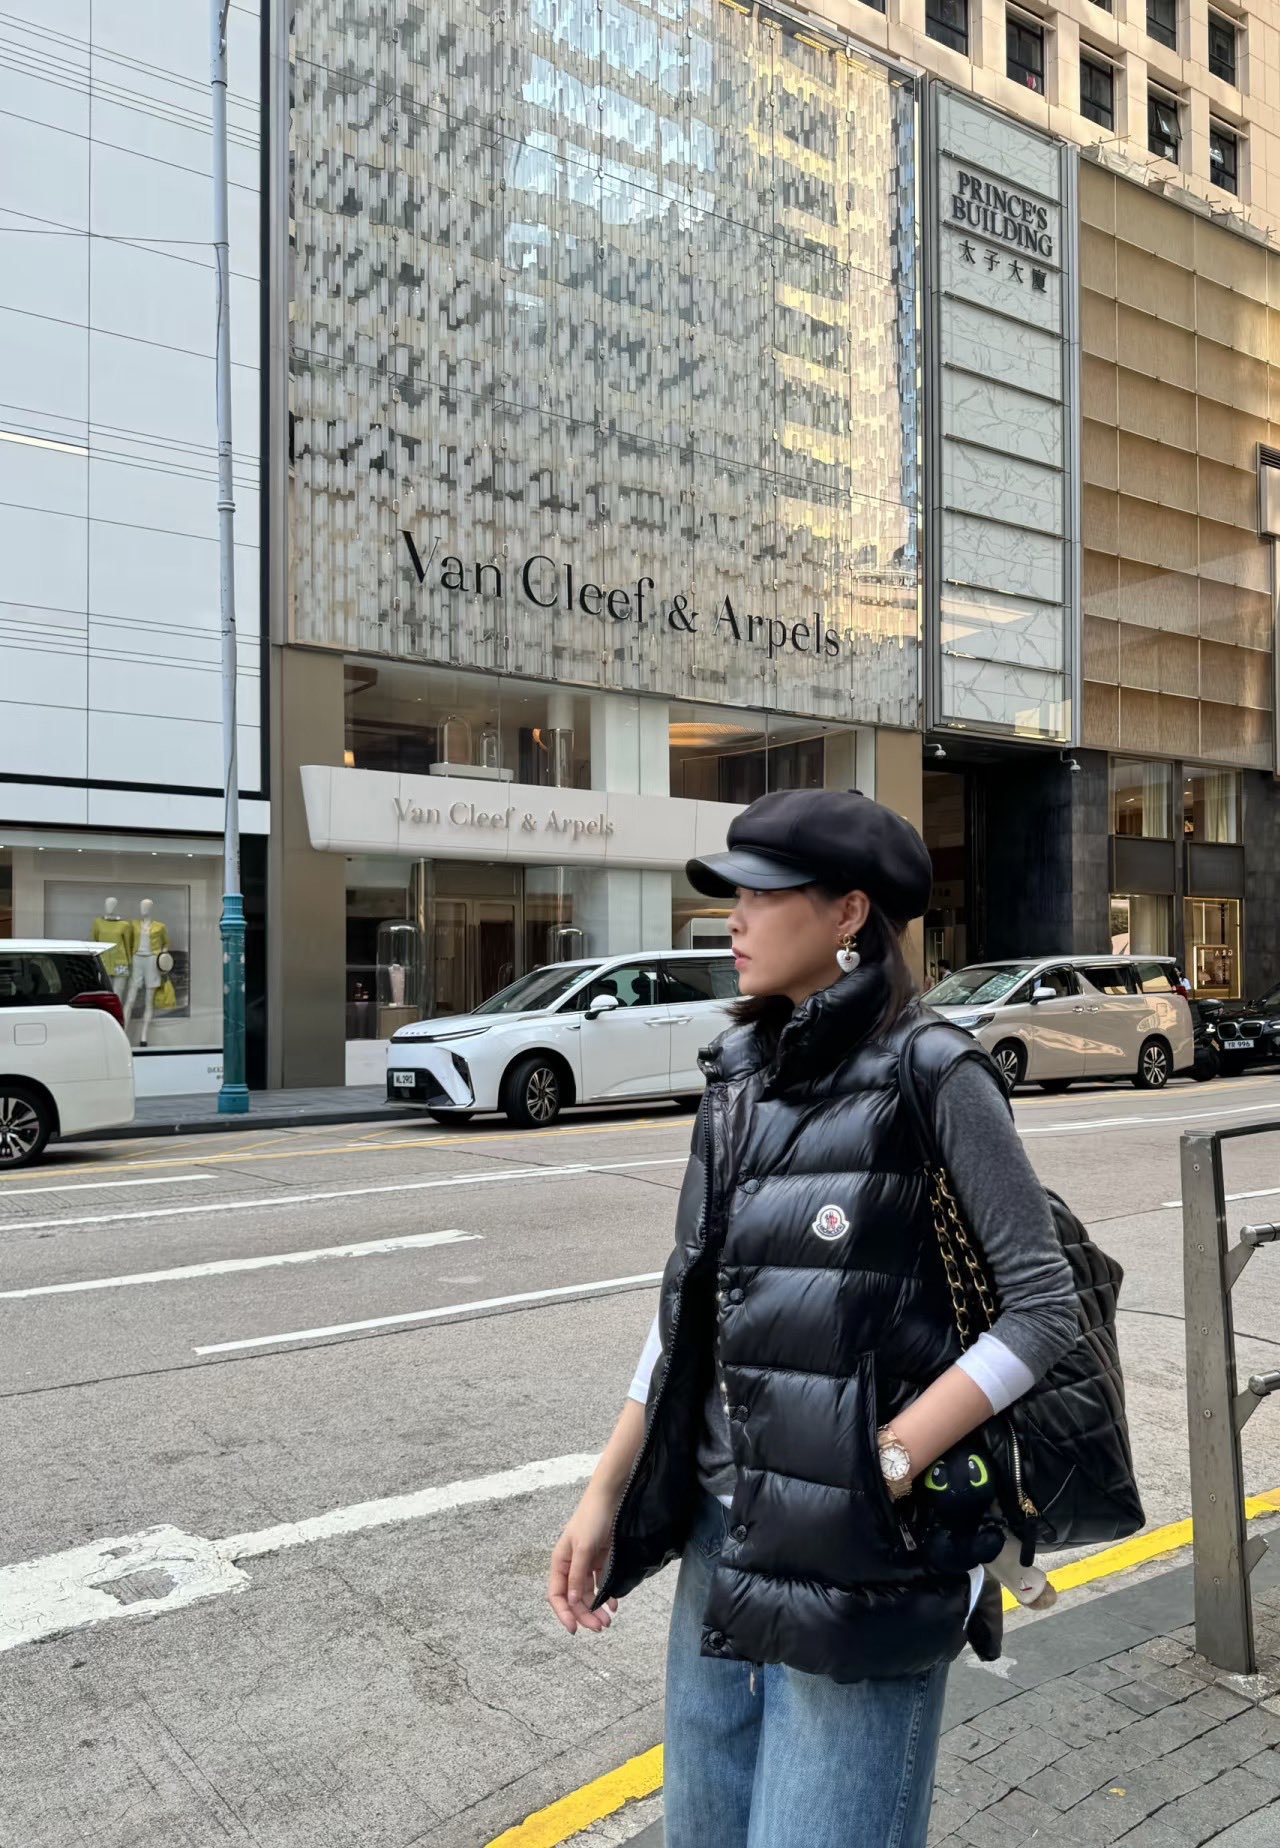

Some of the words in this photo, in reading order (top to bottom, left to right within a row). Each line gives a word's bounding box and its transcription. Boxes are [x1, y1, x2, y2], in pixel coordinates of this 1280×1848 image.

[952, 194, 1053, 257] BUILDING
[958, 170, 1048, 230] PRINCE'S
[958, 239, 1048, 293] 太子大廈
[397, 529, 502, 597] Van
[522, 555, 654, 623] Cleef
[668, 594, 699, 633] &
[713, 593, 840, 659] Arpels
[393, 797, 441, 824] Van
[449, 802, 516, 829] Cleef
[521, 812, 538, 832] &
[545, 809, 614, 841] Arpels
